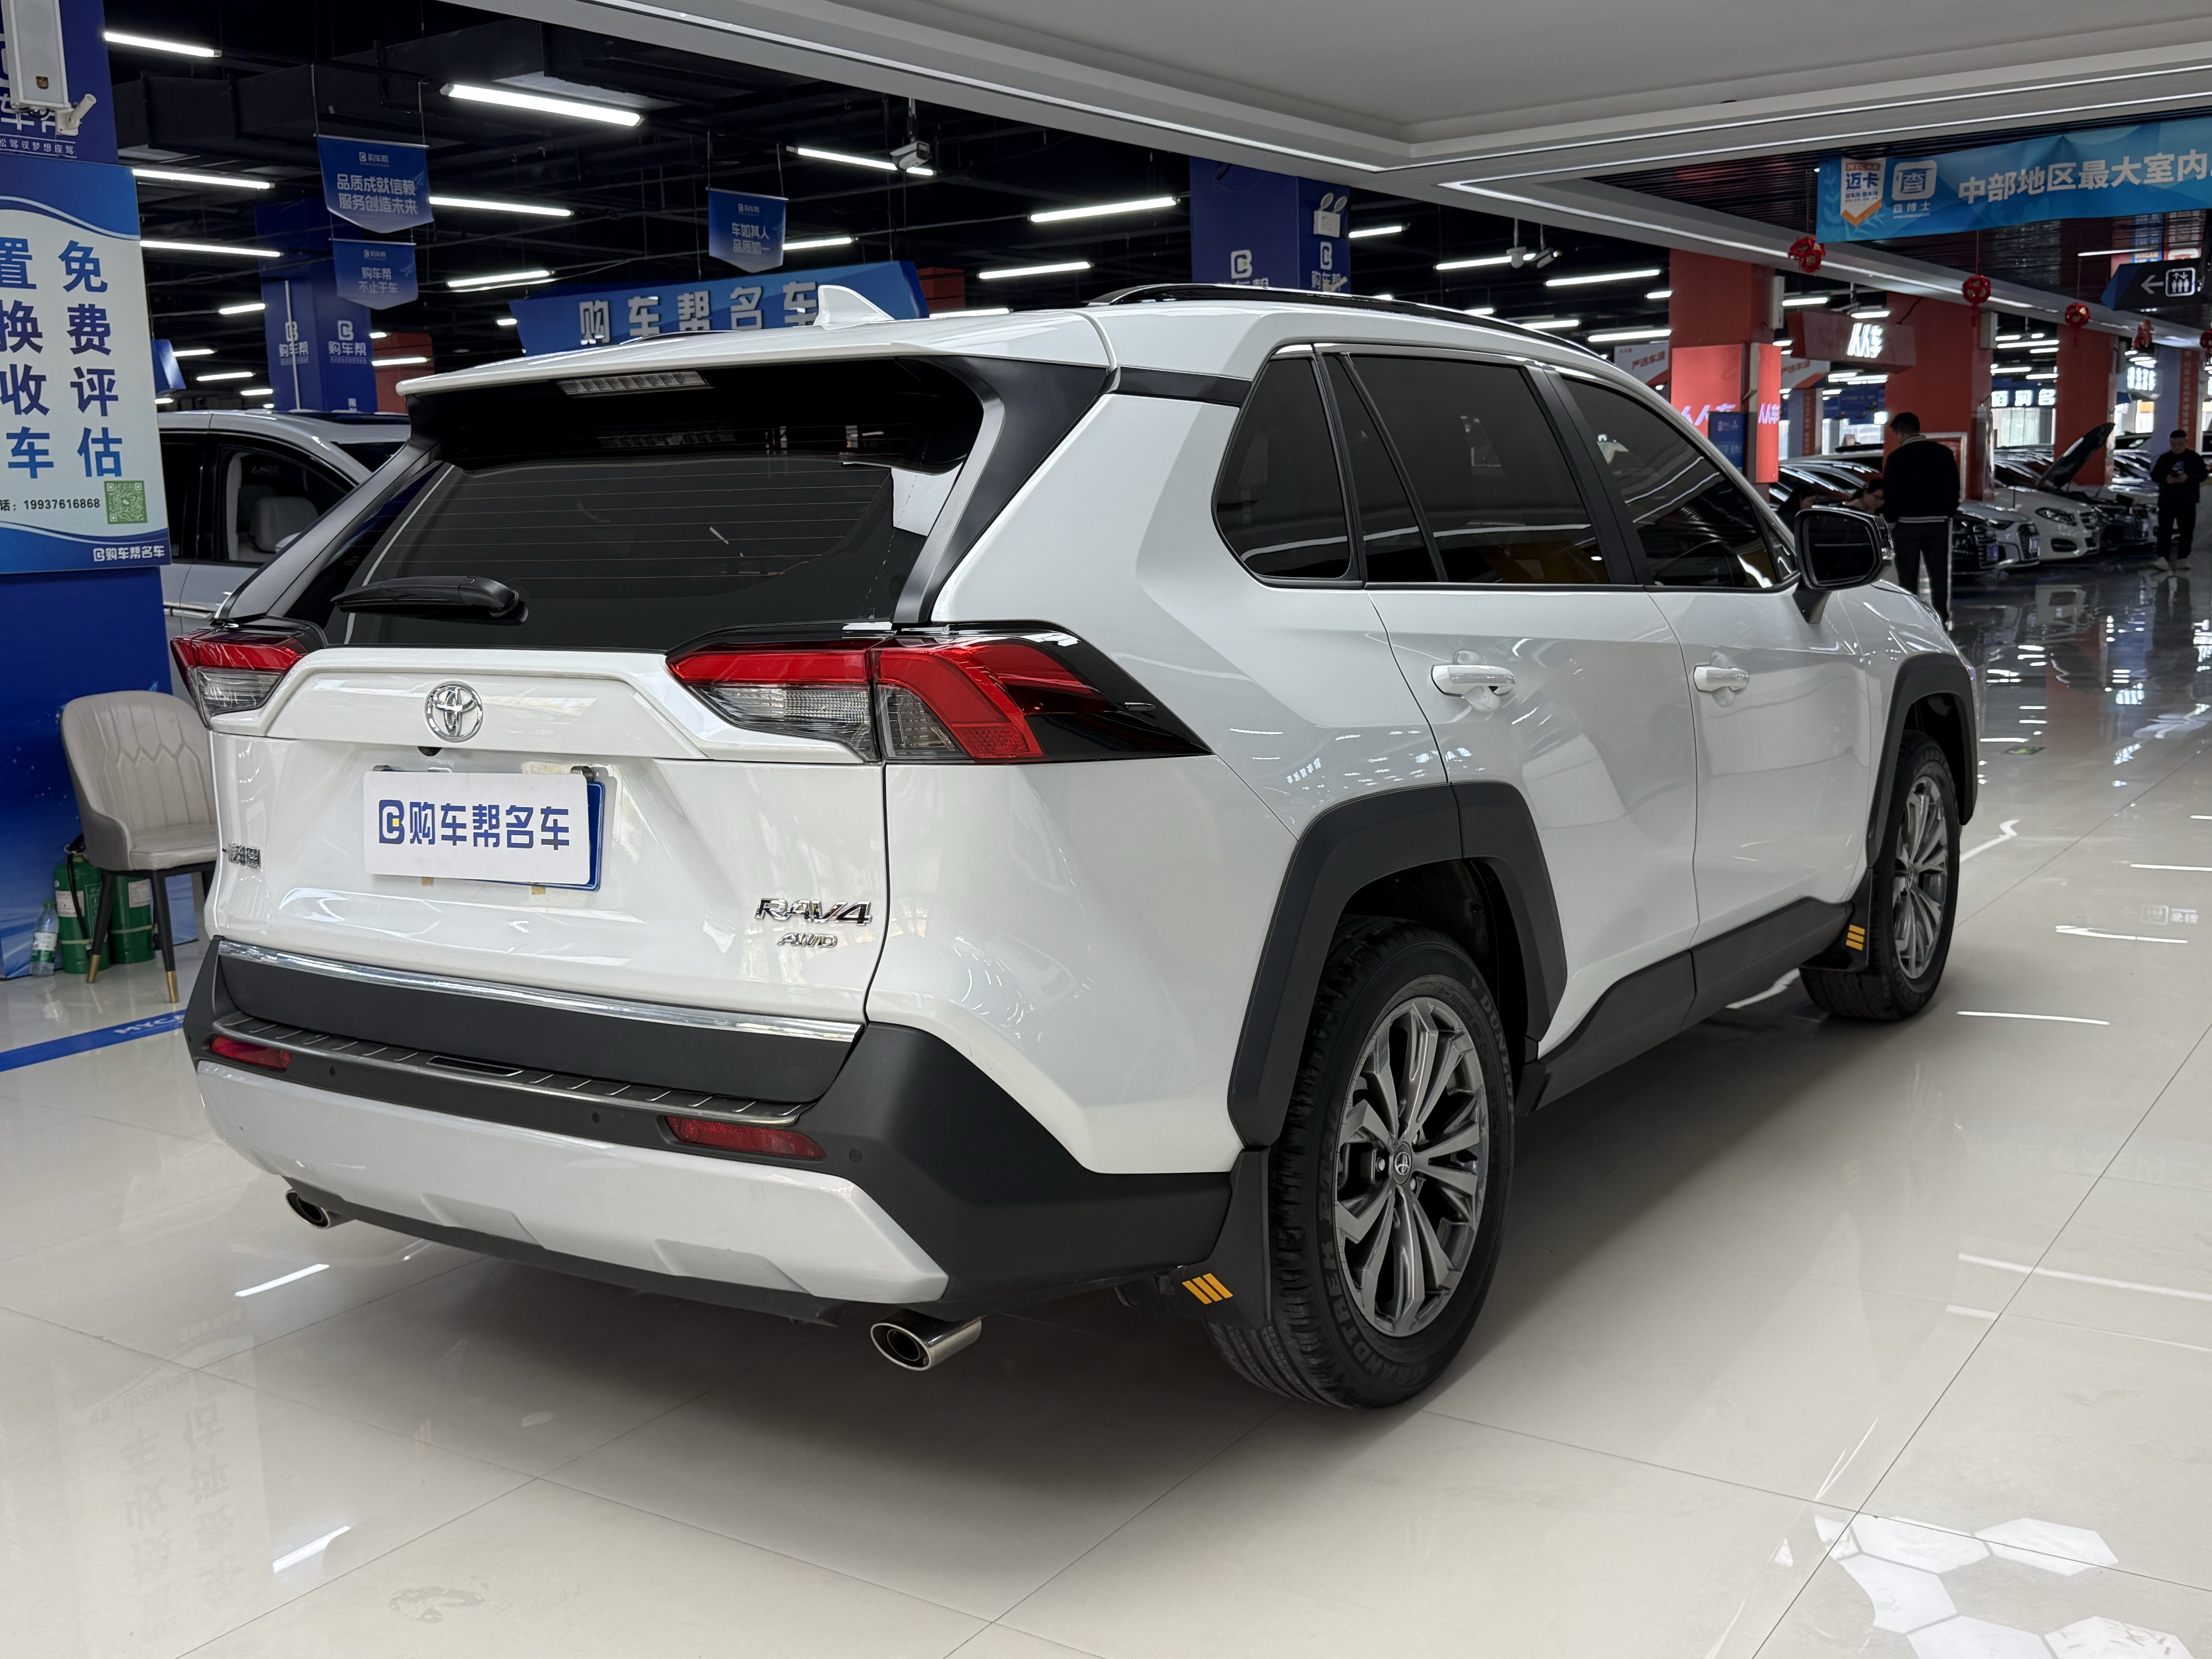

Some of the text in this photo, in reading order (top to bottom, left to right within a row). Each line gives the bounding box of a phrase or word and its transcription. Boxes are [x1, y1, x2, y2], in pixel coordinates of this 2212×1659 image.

[337, 173, 416, 196] 品质成就信赖
[1846, 172, 1879, 190] 迈卡
[1958, 149, 2212, 204] 中部地区最大室内
[338, 193, 418, 215] 服务创造未来
[732, 222, 770, 240] 车如其人
[733, 239, 770, 255] 品质如一
[361, 267, 392, 280] 购车帮
[358, 281, 398, 294] 不止于车
[579, 281, 817, 345] 购车帮名车
[279, 341, 309, 357] 购车帮
[328, 341, 367, 356] 购车帮
[0, 237, 54, 479] 置换收车
[58, 240, 123, 477] 免费评估
[24, 498, 100, 510] 19937616868
[105, 545, 165, 561] 购车帮名车
[409, 801, 570, 850] 购车帮名车
[754, 898, 872, 926] RAV4
[777, 933, 838, 947] AWD
